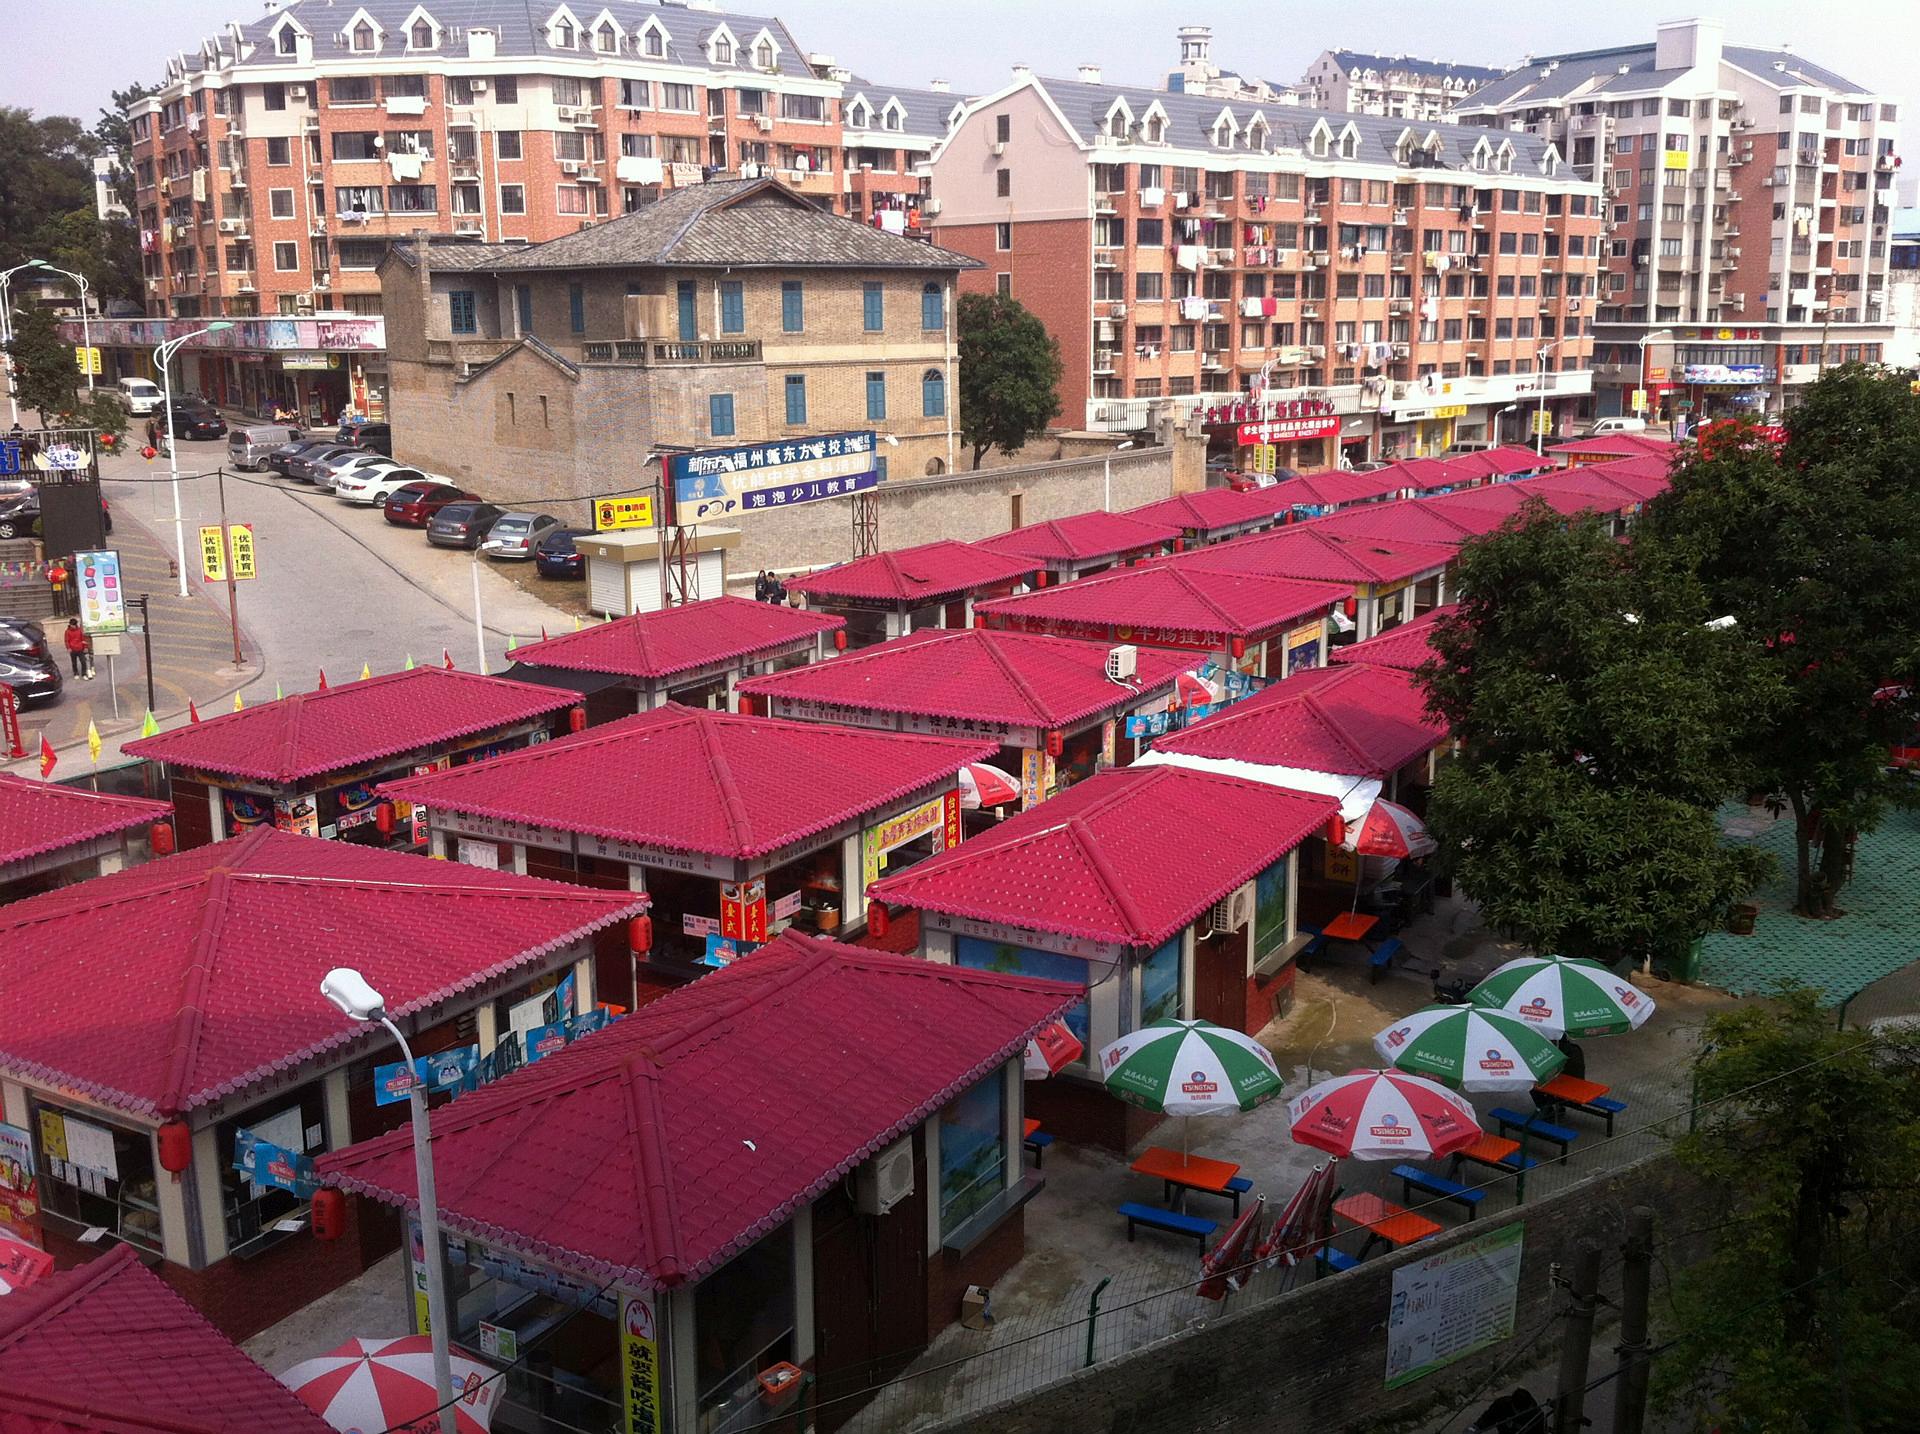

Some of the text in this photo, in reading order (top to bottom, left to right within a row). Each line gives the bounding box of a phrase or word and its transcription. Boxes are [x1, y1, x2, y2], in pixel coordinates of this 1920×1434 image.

[752, 477, 856, 507] 泡泡少儿教育
[1184, 1084, 1216, 1092] TSINGTAO
[1372, 1127, 1409, 1135] TSINGTAO
